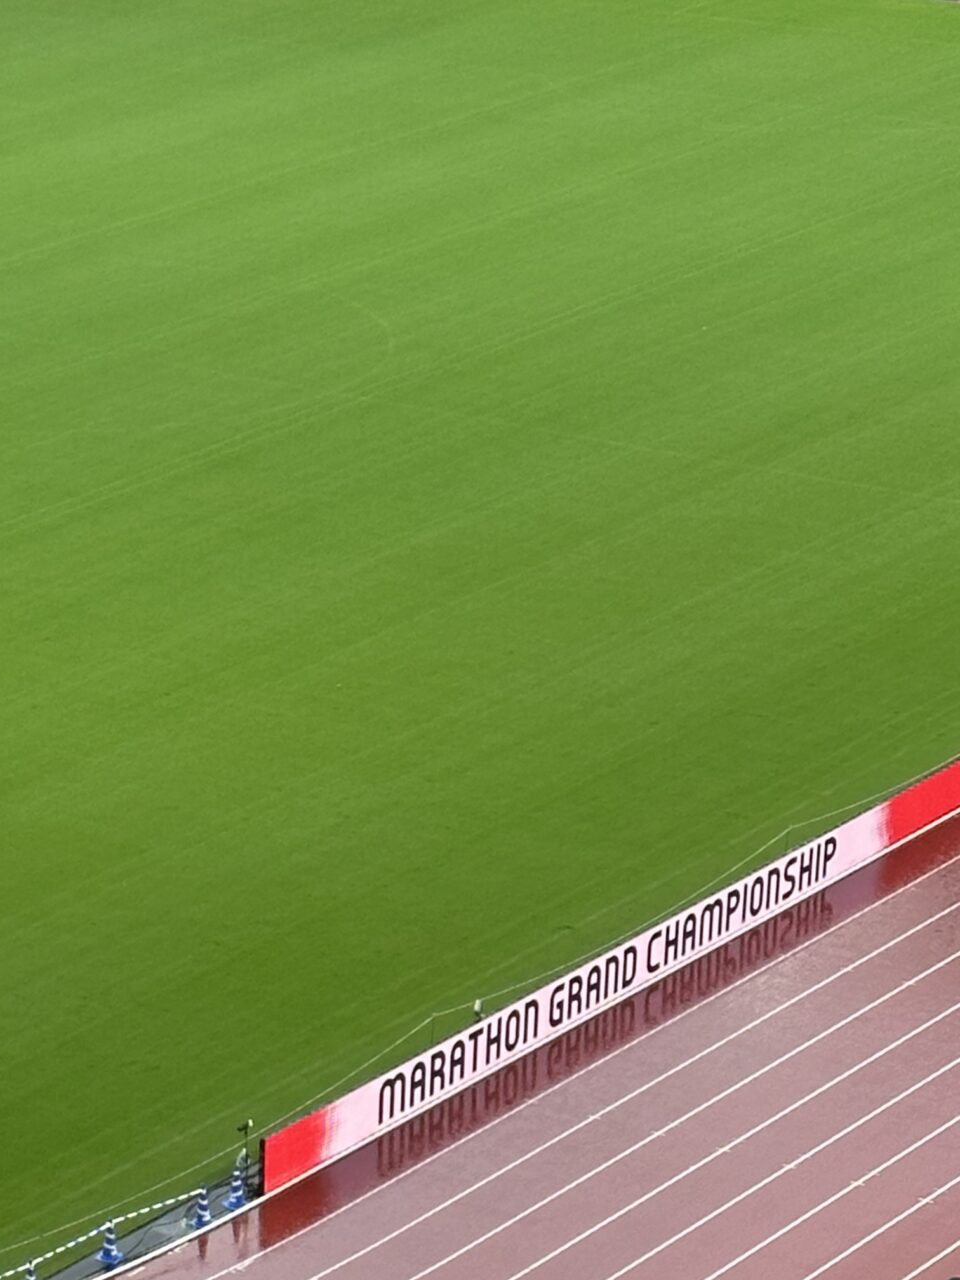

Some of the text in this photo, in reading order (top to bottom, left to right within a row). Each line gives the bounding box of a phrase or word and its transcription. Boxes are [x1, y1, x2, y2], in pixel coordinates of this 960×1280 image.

[378, 836, 838, 1125] MARATHON GRAND CHAMPIONSHIP
